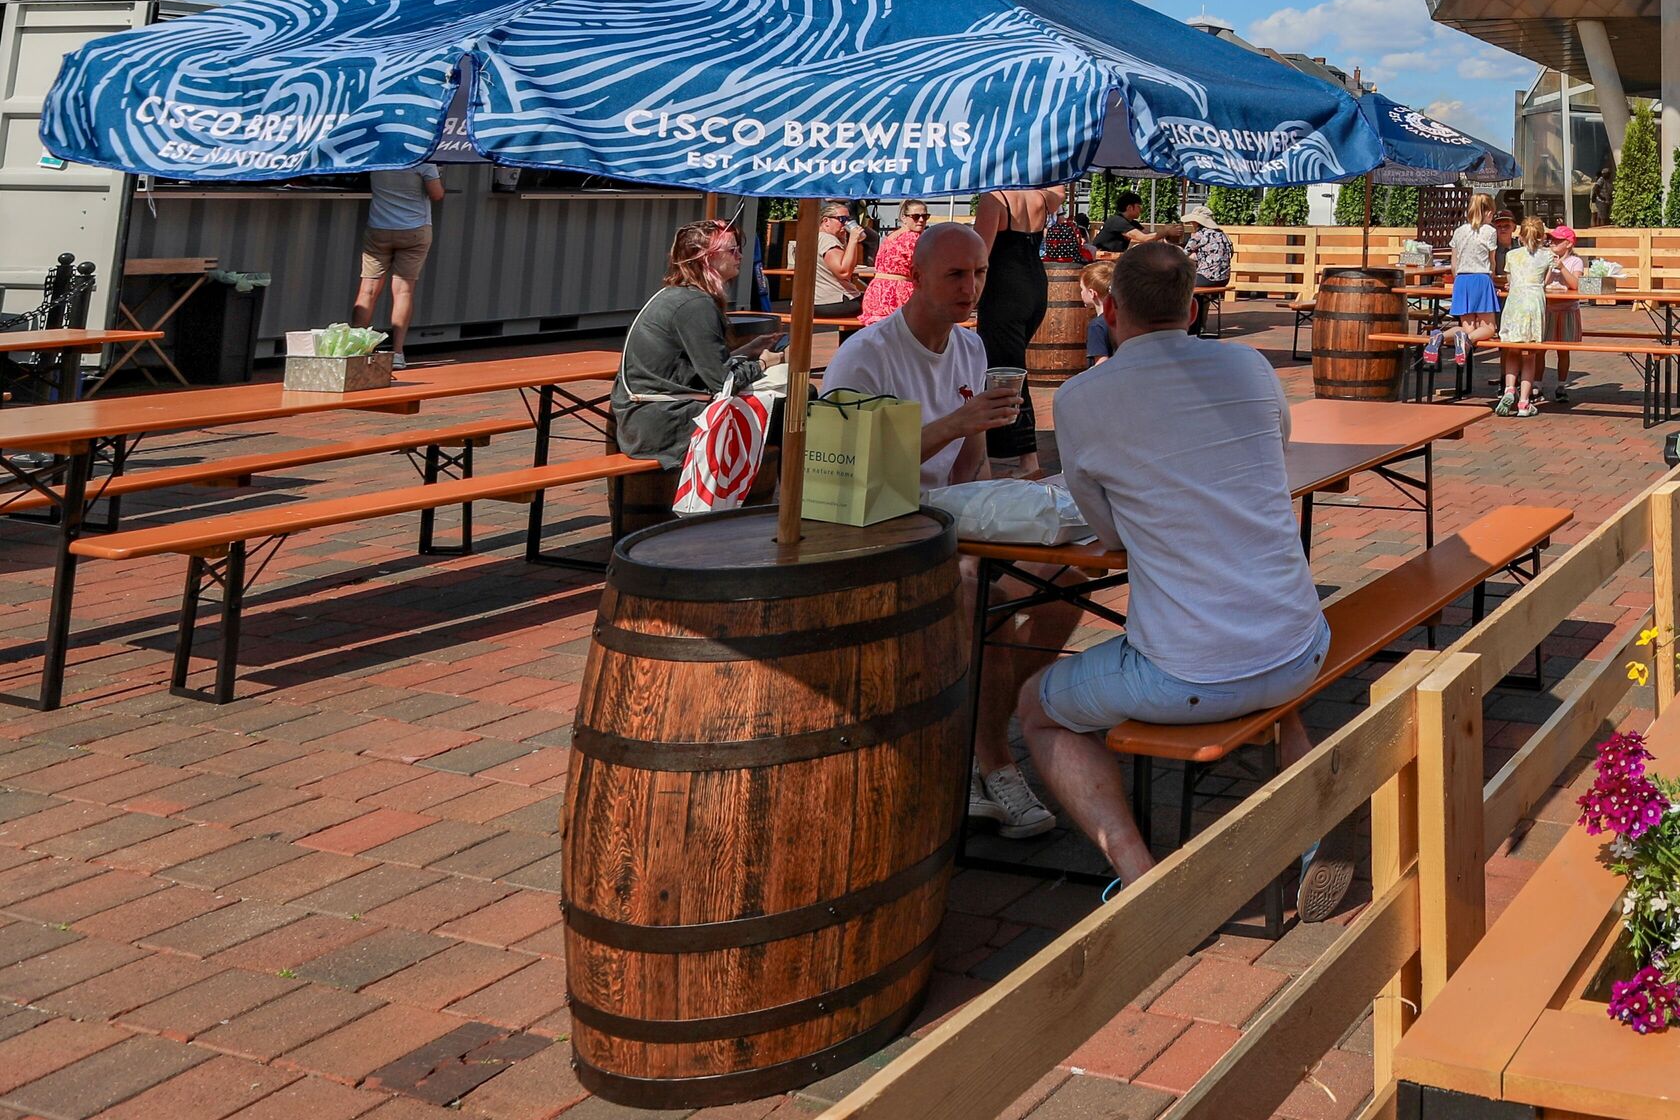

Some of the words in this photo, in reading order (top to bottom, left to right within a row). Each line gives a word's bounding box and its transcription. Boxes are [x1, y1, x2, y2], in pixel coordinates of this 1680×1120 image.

[136, 95, 240, 138] CISCO
[243, 113, 350, 149] BREWE
[624, 109, 766, 147] CISCO
[784, 120, 973, 150] BREWERS
[158, 140, 197, 163] EST.
[1159, 121, 1221, 148] CISCO
[1219, 128, 1302, 154] BREWERS
[687, 151, 739, 169] EST.
[753, 156, 913, 175] NANTUCKET
[1194, 155, 1221, 170] EST.
